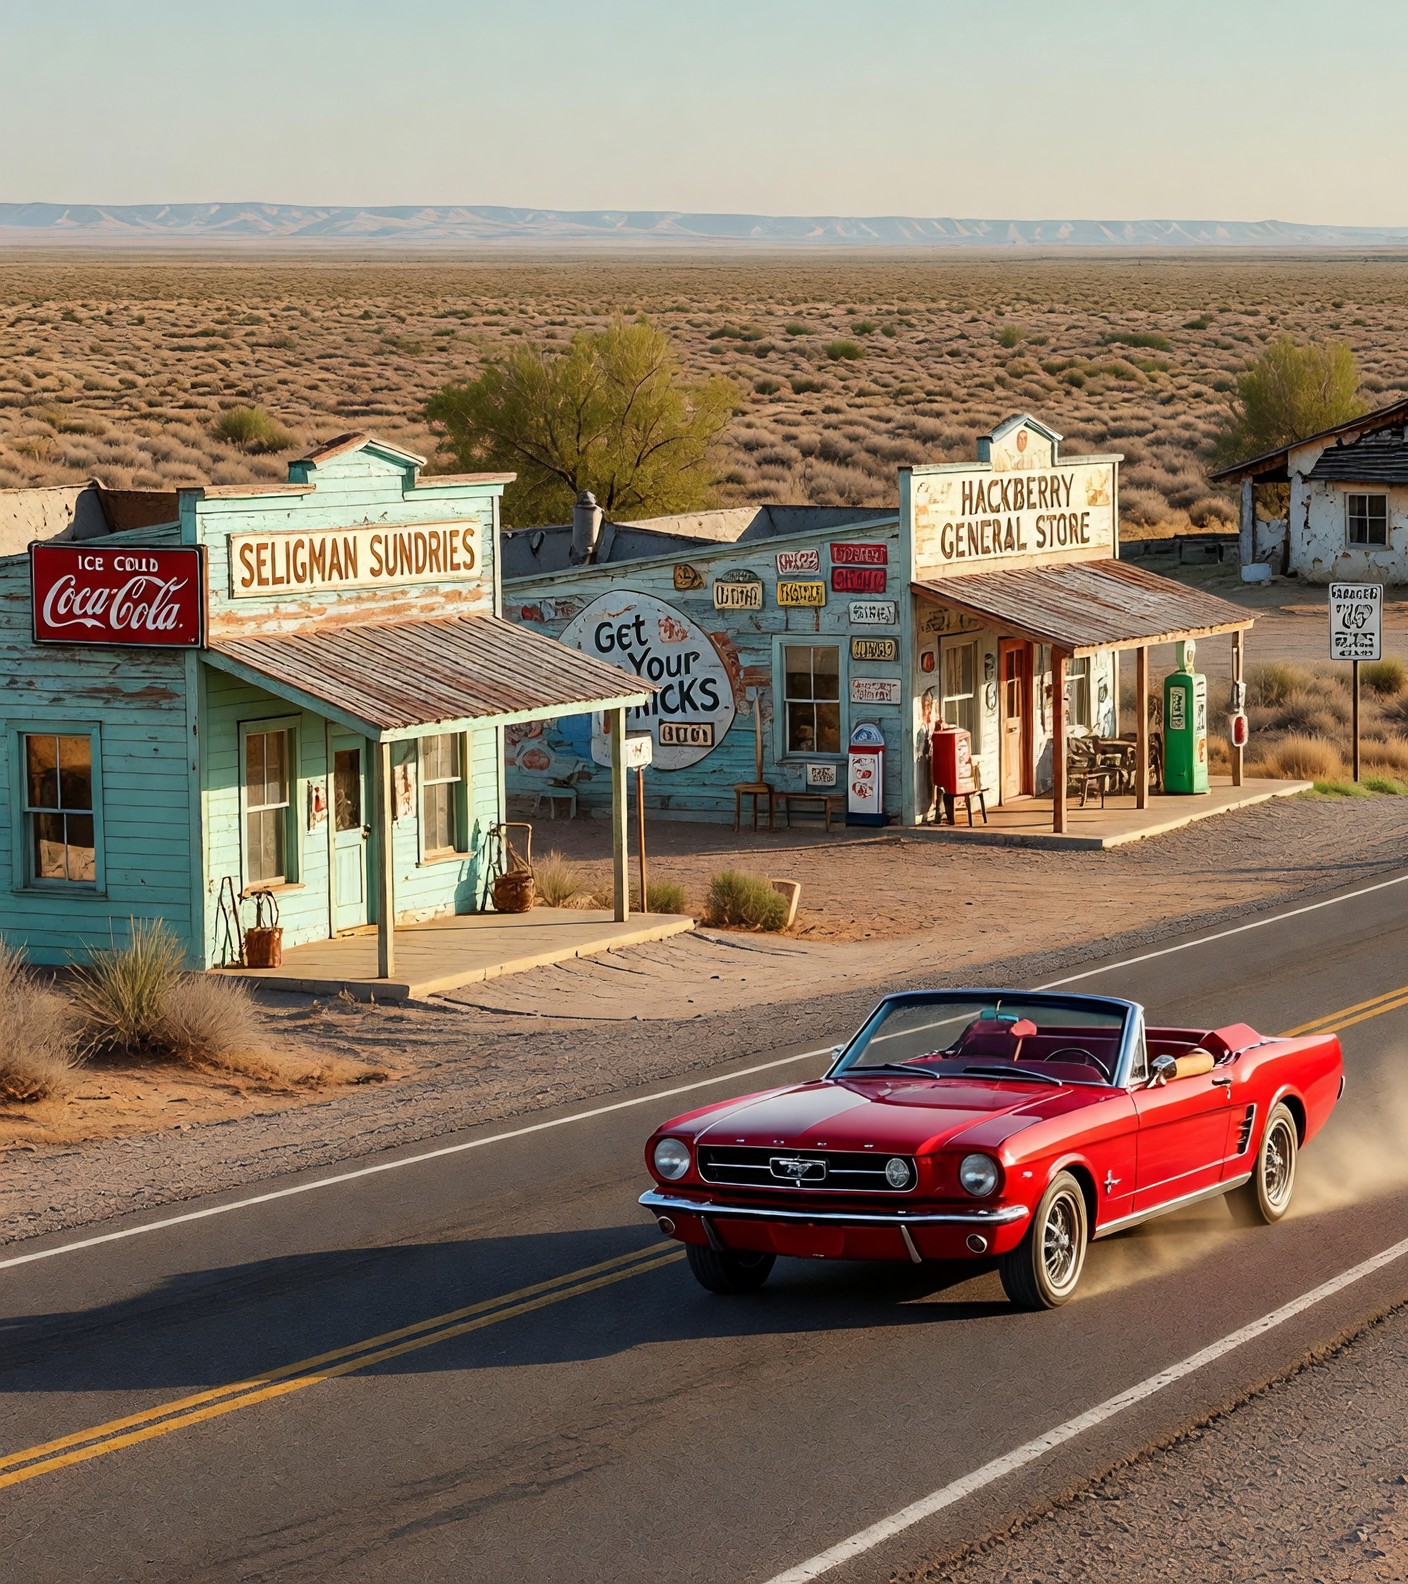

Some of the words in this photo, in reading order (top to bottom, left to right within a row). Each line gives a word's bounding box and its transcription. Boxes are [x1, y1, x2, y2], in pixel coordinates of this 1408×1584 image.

[961, 474, 1075, 516] HACKBERRY
[940, 516, 1027, 560] GENERAL
[1036, 512, 1090, 549] STORE
[77, 555, 104, 571] ICE
[239, 535, 358, 588] SELIGMAN
[369, 528, 475, 578] SUNDRIES
[43, 574, 189, 631] Coca-Cola
[627, 647, 701, 682] Your
[627, 677, 720, 719] ICKS
